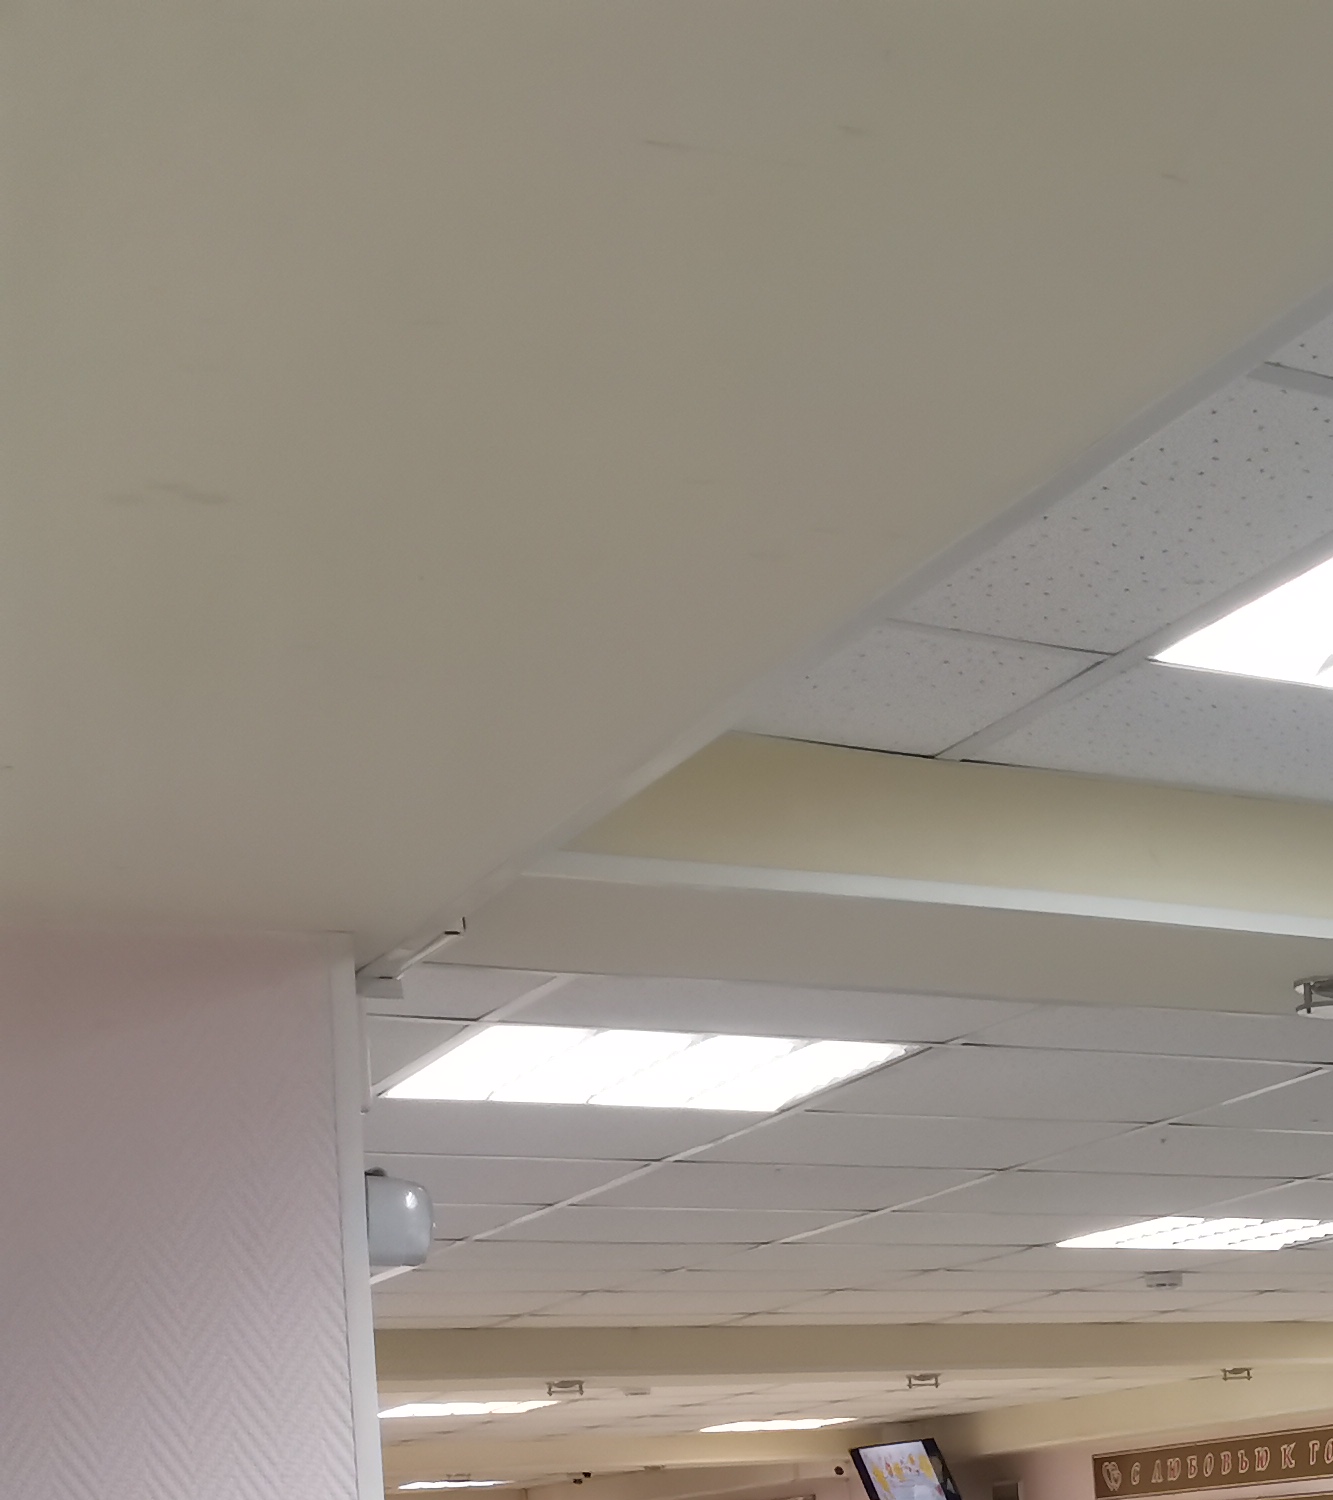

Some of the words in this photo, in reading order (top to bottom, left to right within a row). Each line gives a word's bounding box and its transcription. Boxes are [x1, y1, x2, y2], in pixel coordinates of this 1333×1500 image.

[1130, 1461, 1141, 1486] С
[1151, 1446, 1272, 1484] ЛЮБОВЬЮ
[1280, 1442, 1297, 1470] К
